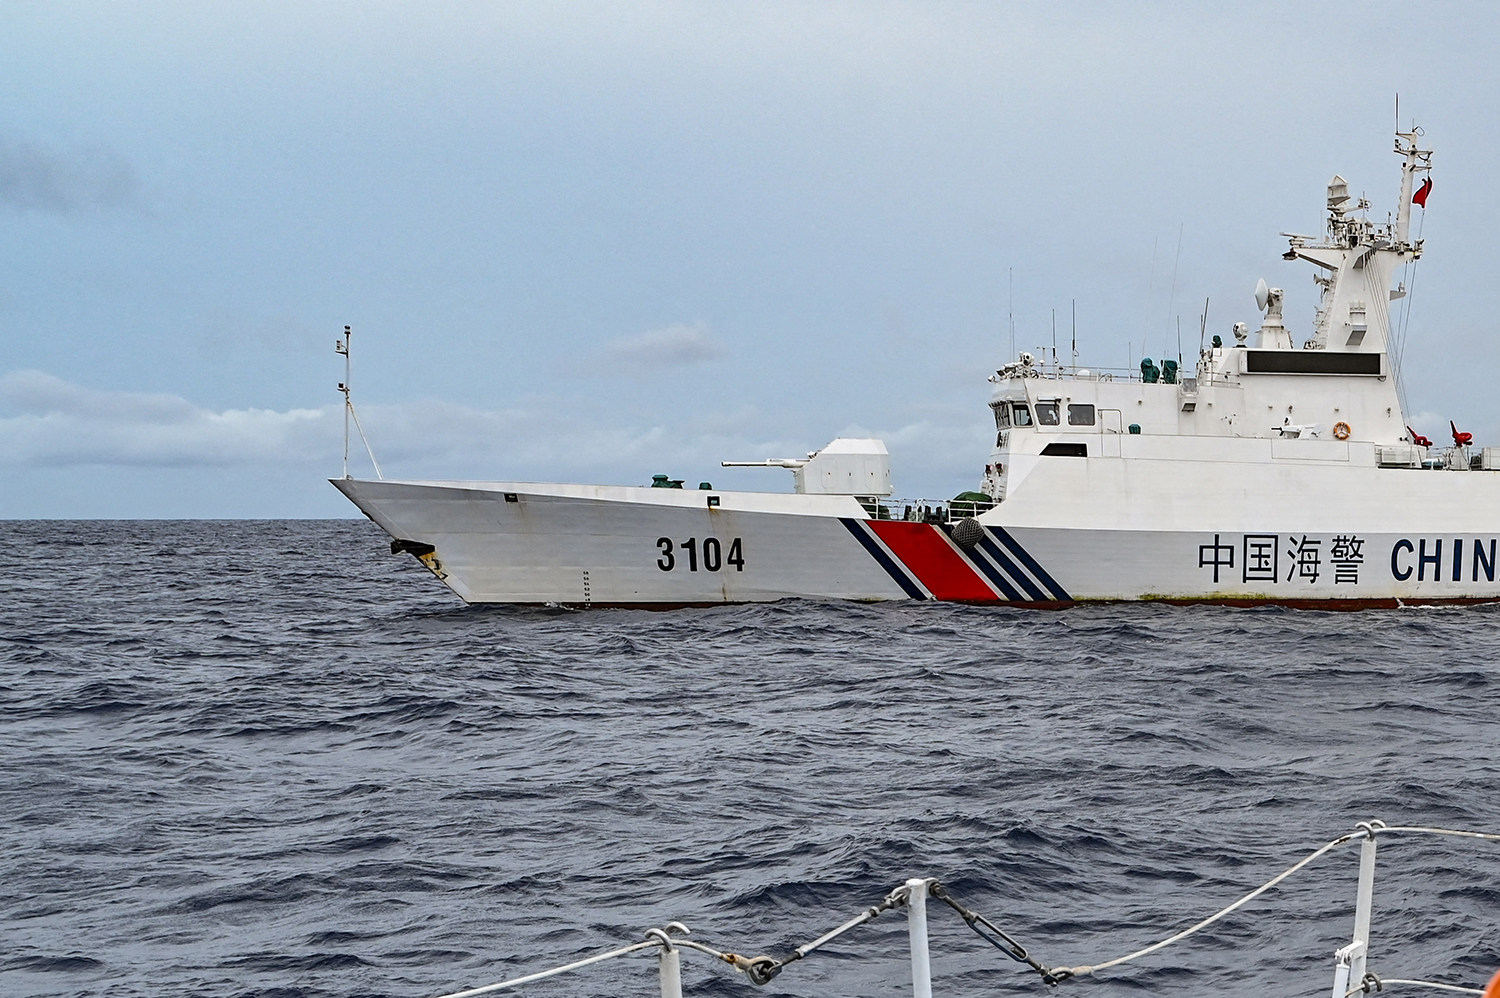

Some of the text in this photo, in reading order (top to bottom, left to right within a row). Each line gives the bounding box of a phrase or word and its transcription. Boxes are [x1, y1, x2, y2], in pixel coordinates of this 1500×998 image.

[656, 537, 745, 572] 3104
[1198, 534, 1365, 584] 中国海警
